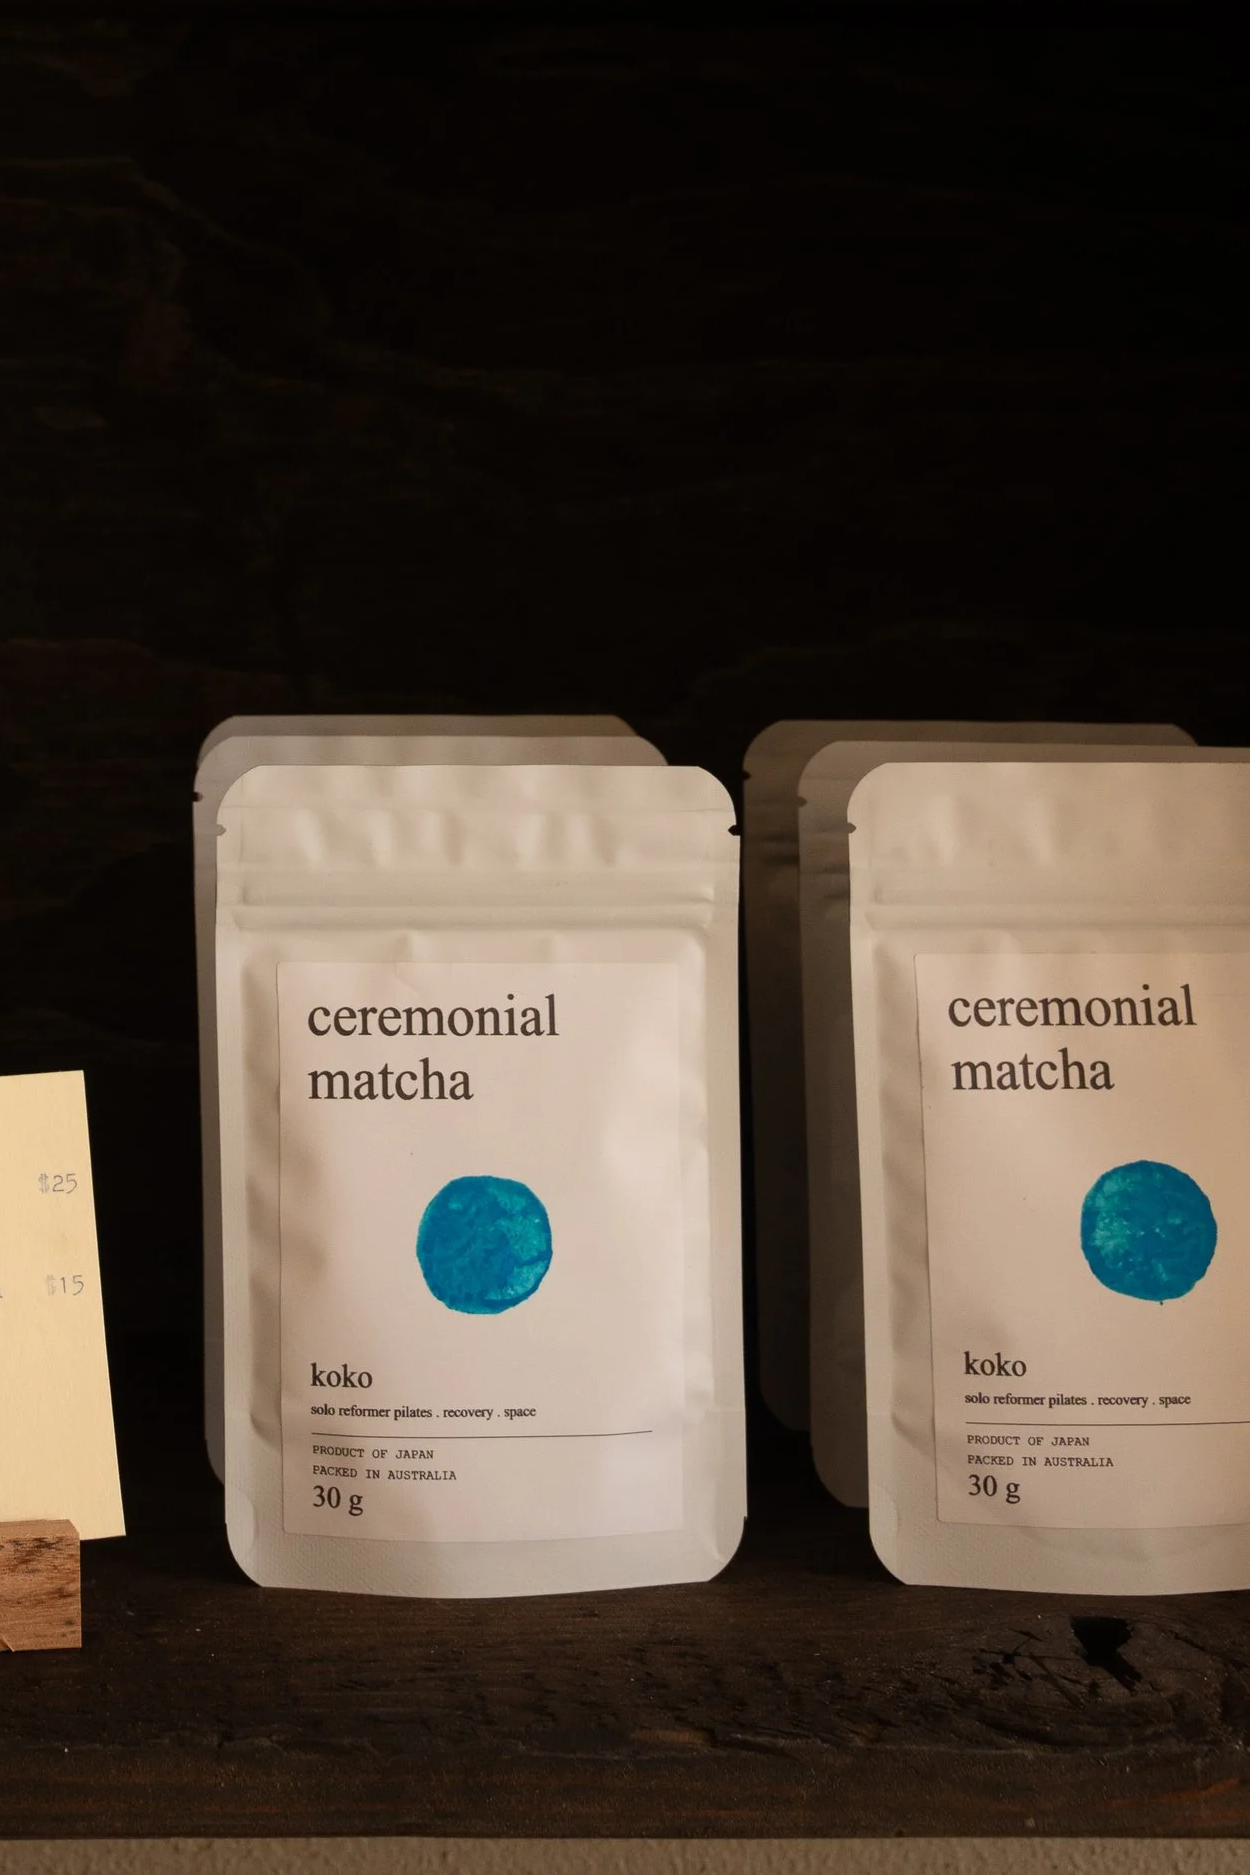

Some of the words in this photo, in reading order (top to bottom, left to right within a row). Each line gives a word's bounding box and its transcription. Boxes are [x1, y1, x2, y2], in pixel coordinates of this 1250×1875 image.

[307, 993, 560, 1037] ceremonial
[947, 983, 1198, 1028] ceremonial
[307, 1056, 475, 1101] matcha
[950, 1046, 1116, 1091] matcha
[37, 1172, 78, 1195] $25
[46, 1274, 85, 1297] $15
[310, 1361, 374, 1389] koko
[963, 1350, 1027, 1378] koko
[310, 1403, 336, 1416] solo
[338, 1404, 392, 1418] reformer
[393, 1405, 433, 1422] pilates
[442, 1408, 494, 1421] recovery
[503, 1408, 537, 1421] space
[964, 1391, 991, 1405] solo
[993, 1392, 1046, 1406] reformer
[1048, 1393, 1088, 1409] pilates
[1097, 1396, 1149, 1409] recovery
[1158, 1395, 1192, 1409] space
[312, 1444, 365, 1459] PRODUCT
[371, 1448, 389, 1459] OF
[395, 1449, 434, 1460] JAPAN
[966, 1434, 1021, 1446] PRODUCT
[1027, 1436, 1045, 1446] OF
[1050, 1436, 1090, 1447] JAPAN
[312, 1464, 358, 1478] PACKED
[365, 1468, 381, 1480] IN
[387, 1469, 457, 1481] AUSTRALIA
[967, 1454, 1015, 1466] PACKED
[1021, 1456, 1037, 1467] IN
[1043, 1456, 1115, 1468] AUSTRALIA
[312, 1484, 342, 1510] 30
[348, 1494, 364, 1517] g
[968, 1473, 998, 1498] 30
[1005, 1482, 1021, 1505] g
